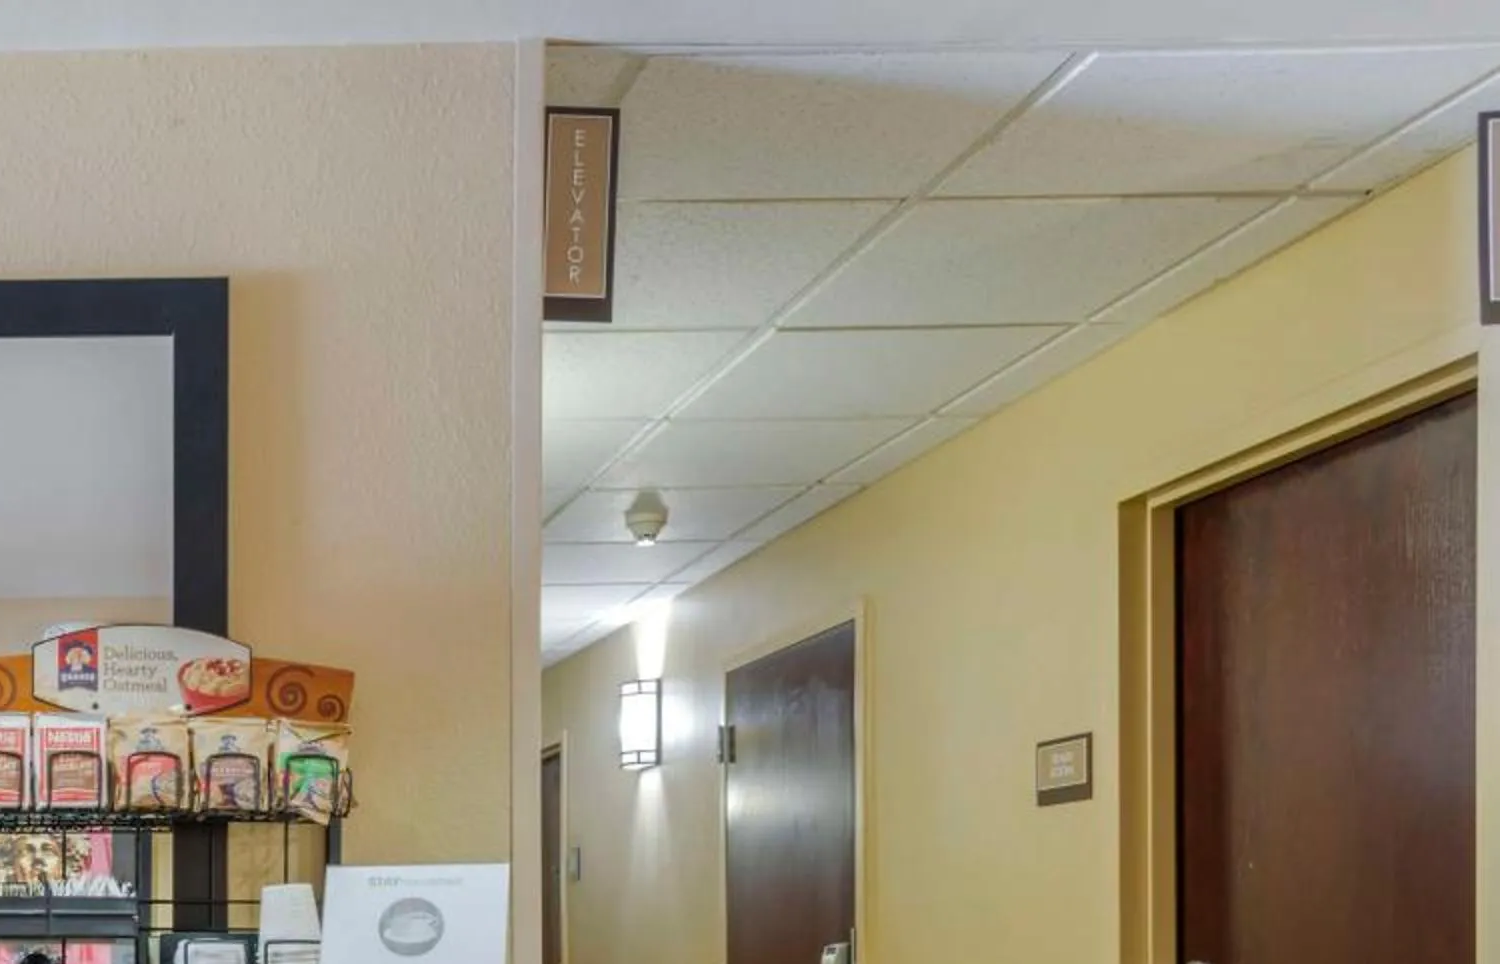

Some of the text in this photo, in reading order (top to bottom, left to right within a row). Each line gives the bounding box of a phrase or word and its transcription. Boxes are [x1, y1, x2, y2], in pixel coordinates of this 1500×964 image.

[567, 128, 587, 286] ELEVATOR
[103, 644, 179, 661] Delicious,
[103, 661, 158, 678] Hearty
[103, 678, 168, 693] Oatmeal
